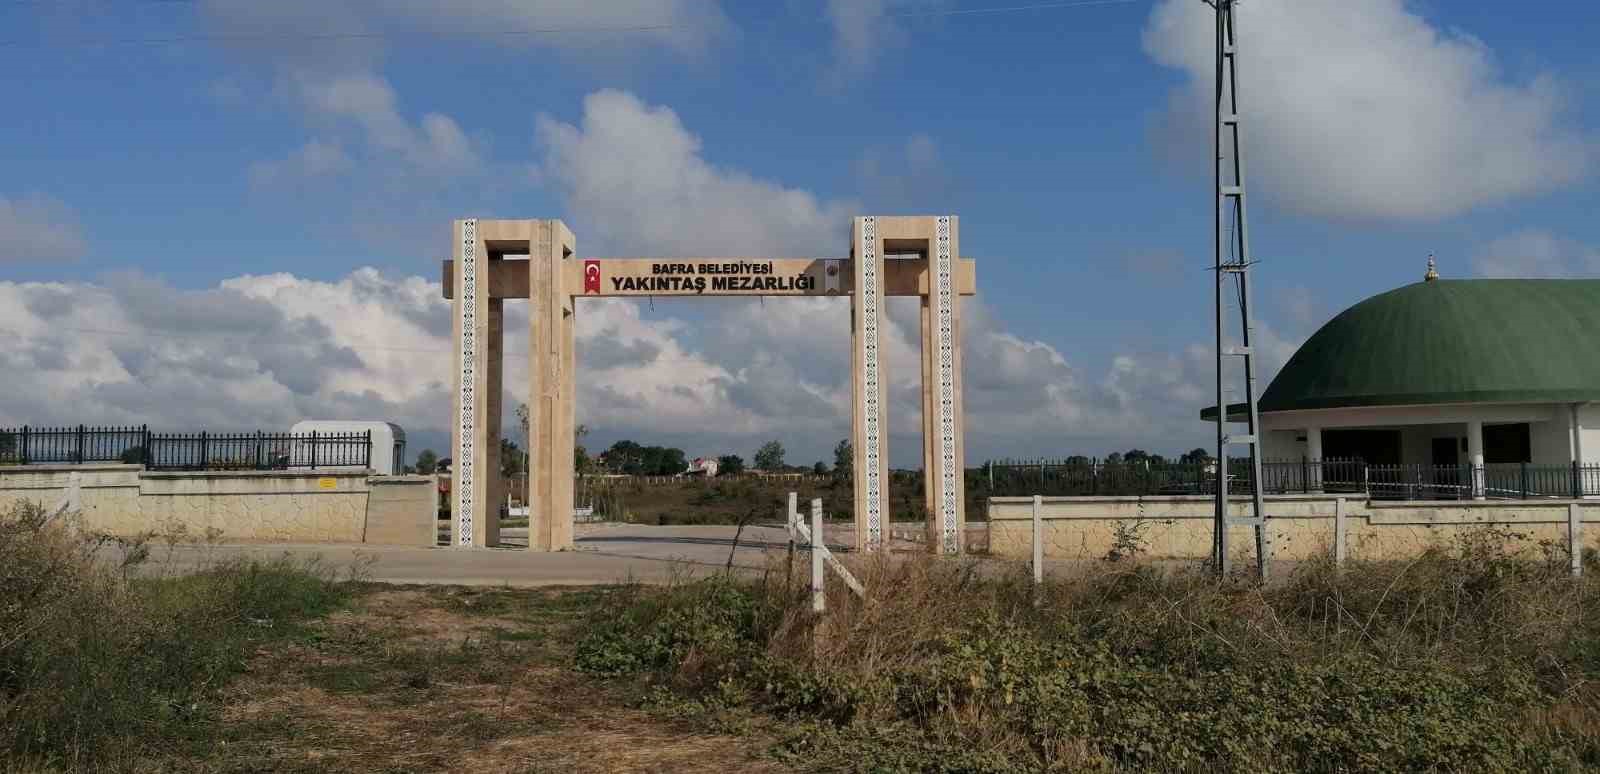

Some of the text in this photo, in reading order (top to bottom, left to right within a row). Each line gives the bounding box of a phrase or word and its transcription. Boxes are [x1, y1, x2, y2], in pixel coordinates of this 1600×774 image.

[652, 260, 773, 274] BAFRA BELEDİYESİ
[611, 273, 815, 293] YAKINTAŞ MEZARLIĞI
